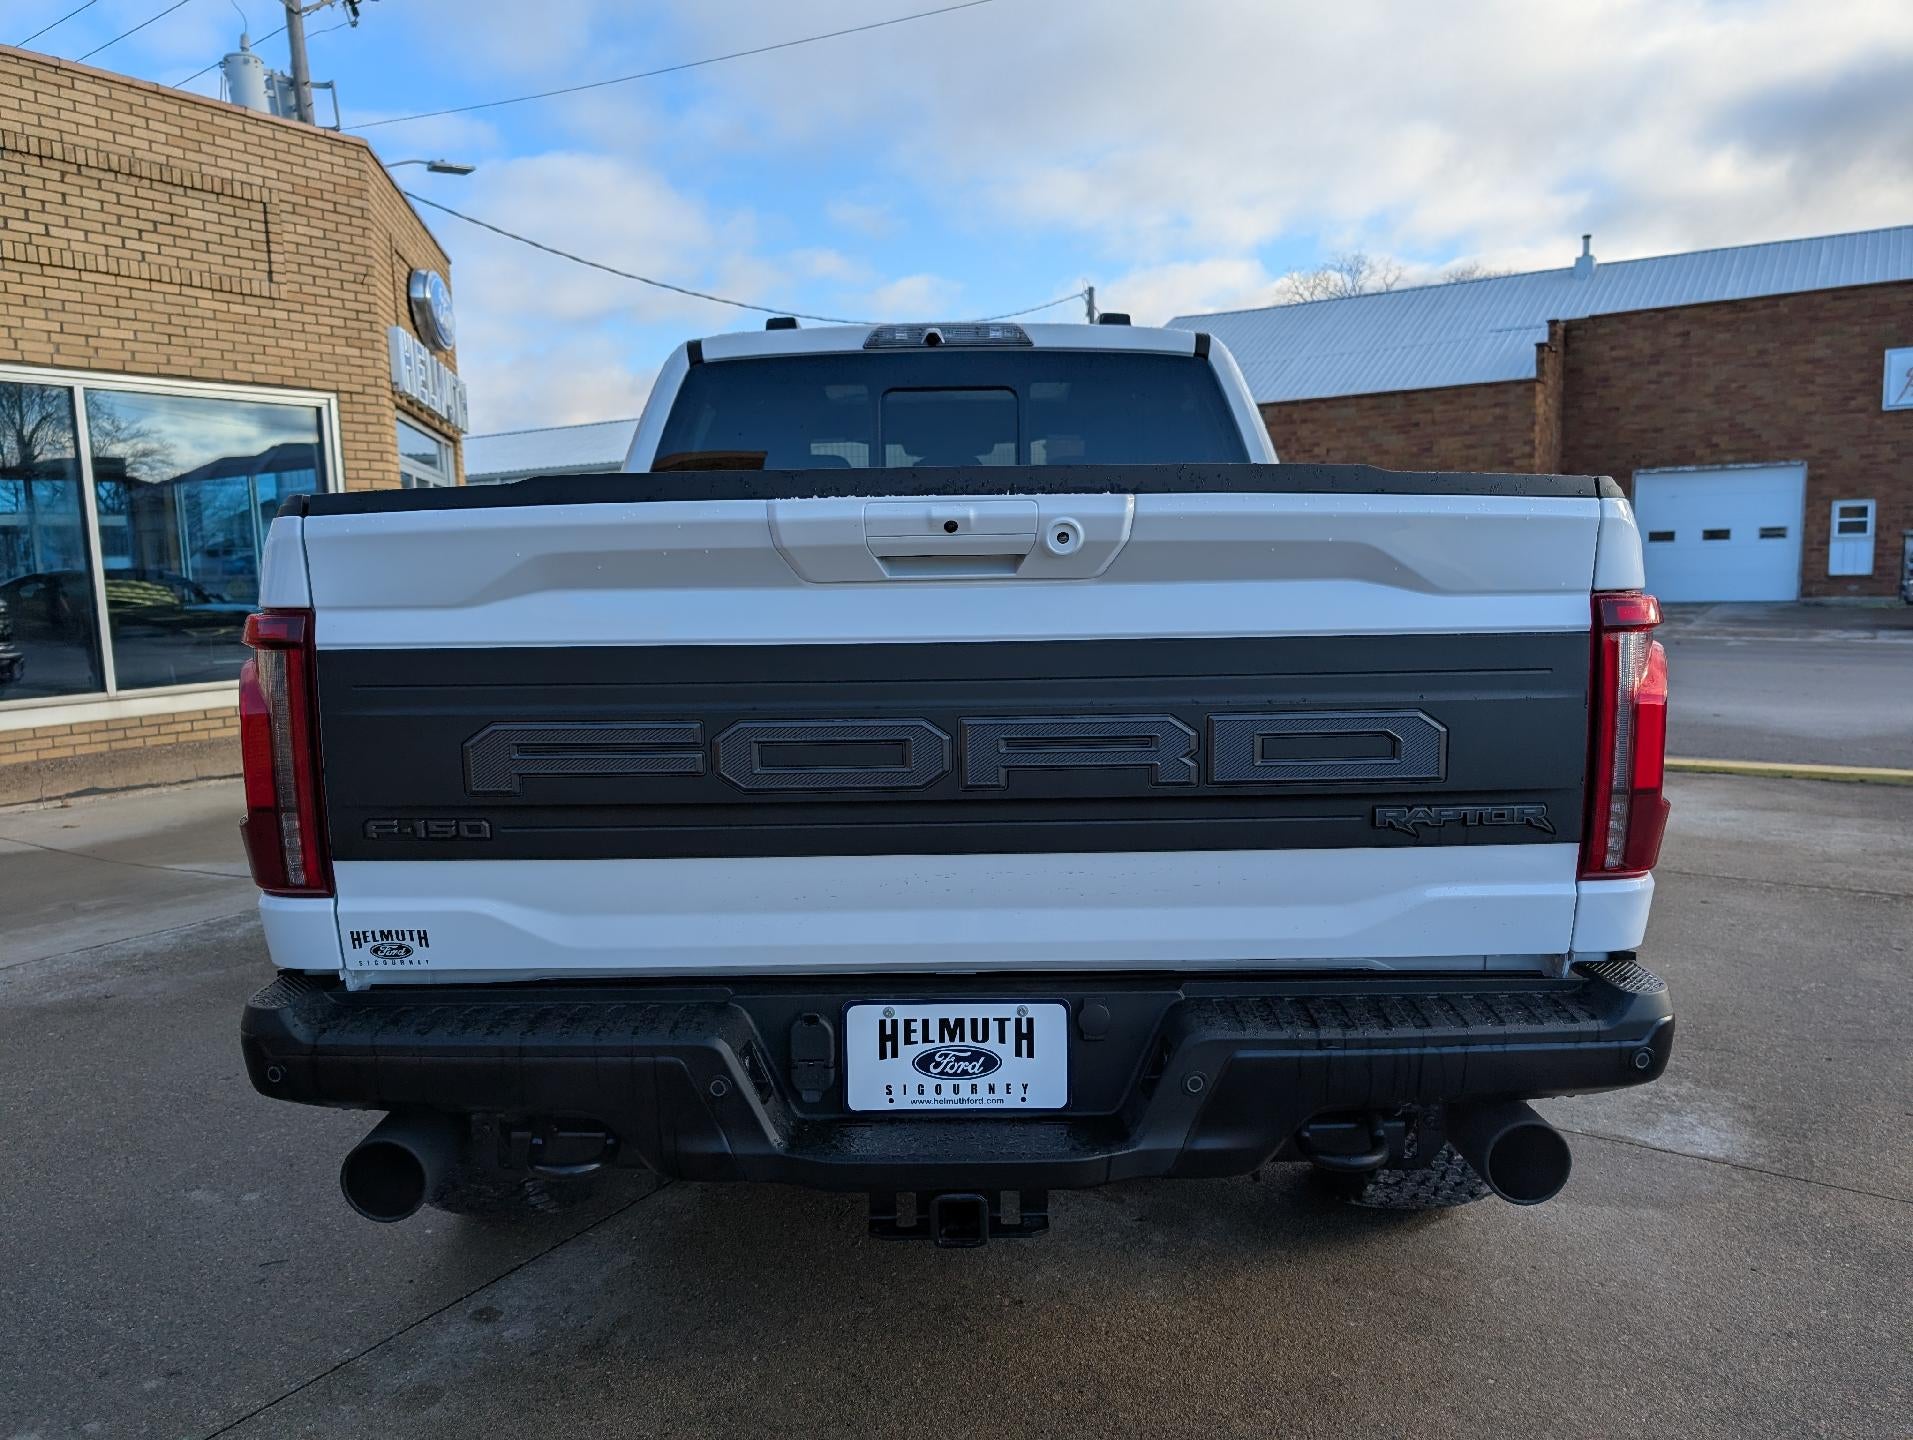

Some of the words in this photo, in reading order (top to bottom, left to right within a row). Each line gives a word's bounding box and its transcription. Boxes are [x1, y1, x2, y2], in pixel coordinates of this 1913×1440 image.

[464, 708, 1449, 795] FORD
[366, 819, 492, 840] F-150
[1375, 805, 1556, 838] RAPTOR
[350, 929, 430, 949] HELMUTH
[878, 1017, 1035, 1061] HELMUTH
[929, 1050, 984, 1075] Ford
[885, 1083, 1029, 1096] SIGOURNEY
[910, 1097, 1004, 1105] www.helmuthford.com
